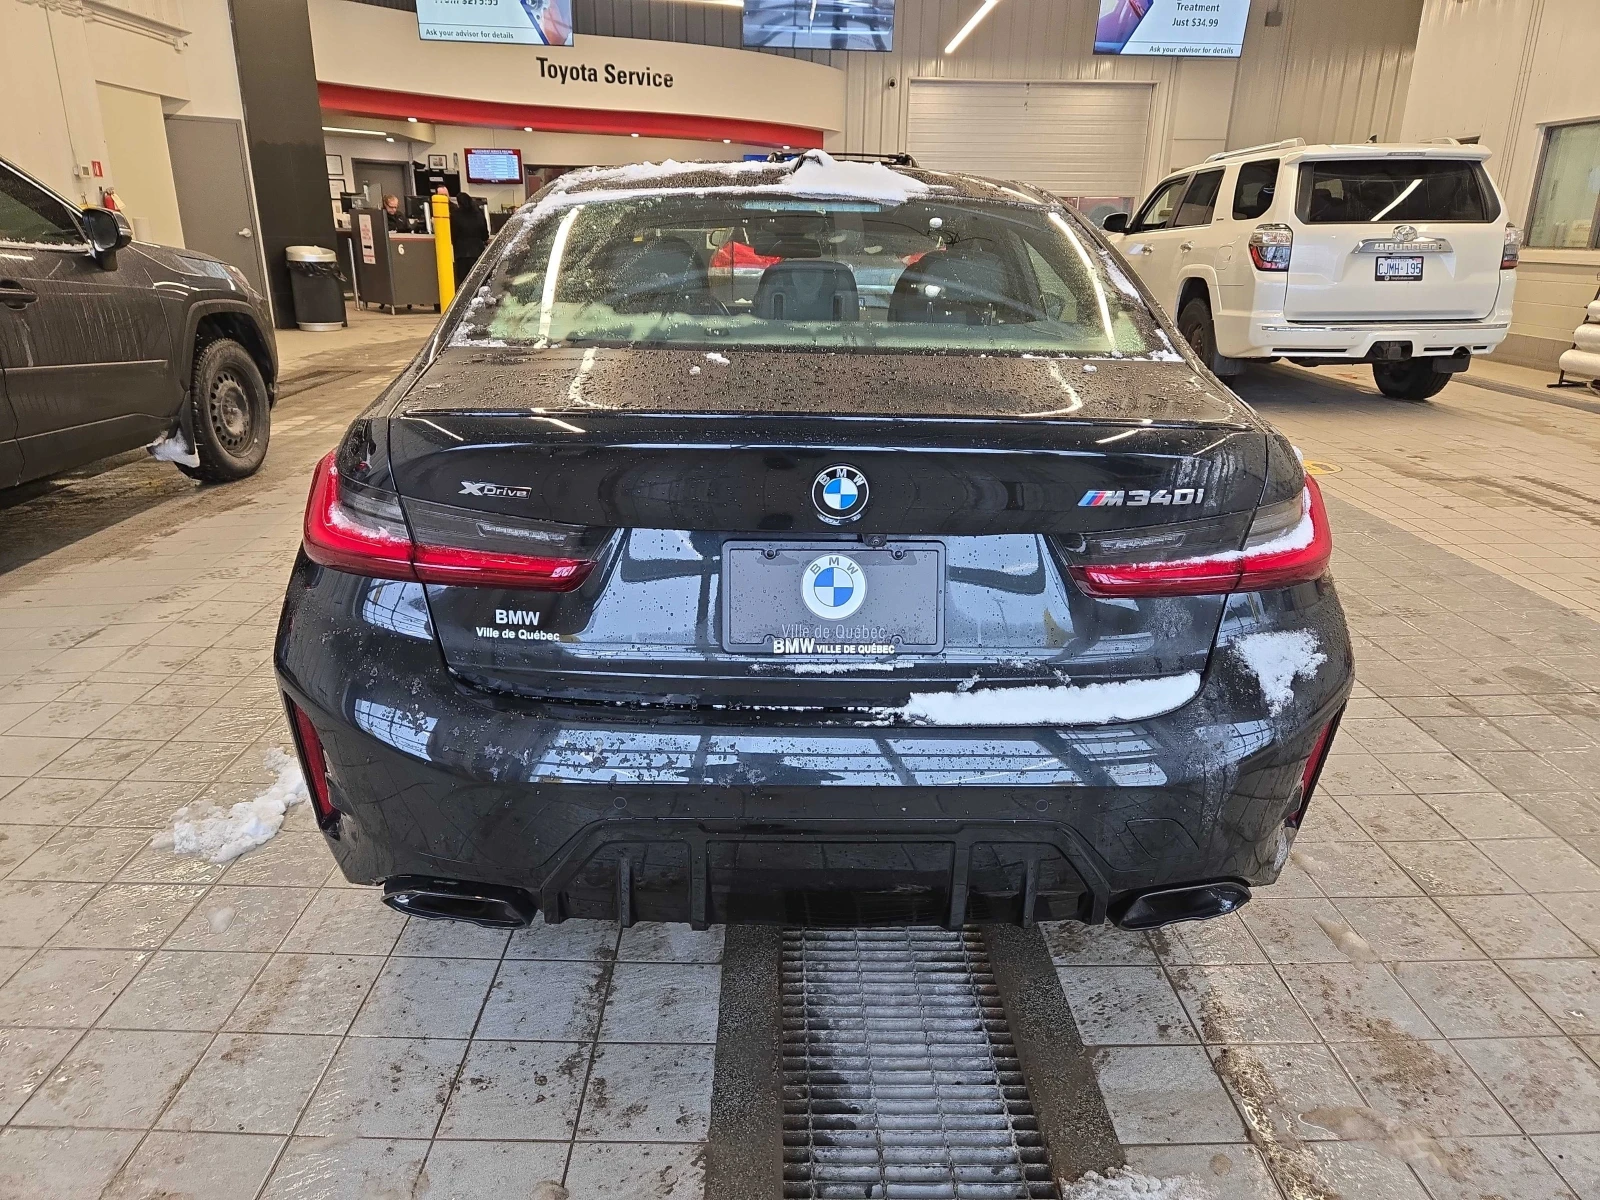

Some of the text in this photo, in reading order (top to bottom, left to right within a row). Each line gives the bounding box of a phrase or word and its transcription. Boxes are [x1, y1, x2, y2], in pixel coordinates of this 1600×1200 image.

[1176, 2, 1220, 12] Treatment
[1172, 17, 1219, 28] Just $34.99
[426, 28, 438, 36] Ask
[439, 30, 454, 38] your
[455, 29, 479, 38] advisor
[492, 31, 514, 39] details
[1149, 45, 1234, 55] Ask your advisor for details
[536, 56, 674, 88] Toyota Service
[397, 243, 405, 255] 6
[809, 556, 859, 575] BMW
[495, 609, 540, 626] BMW
[475, 626, 560, 641] Ville de Québec
[781, 623, 886, 639] Ville de Québec
[773, 637, 896, 655] BMW VILLE DE QUÉBEC
